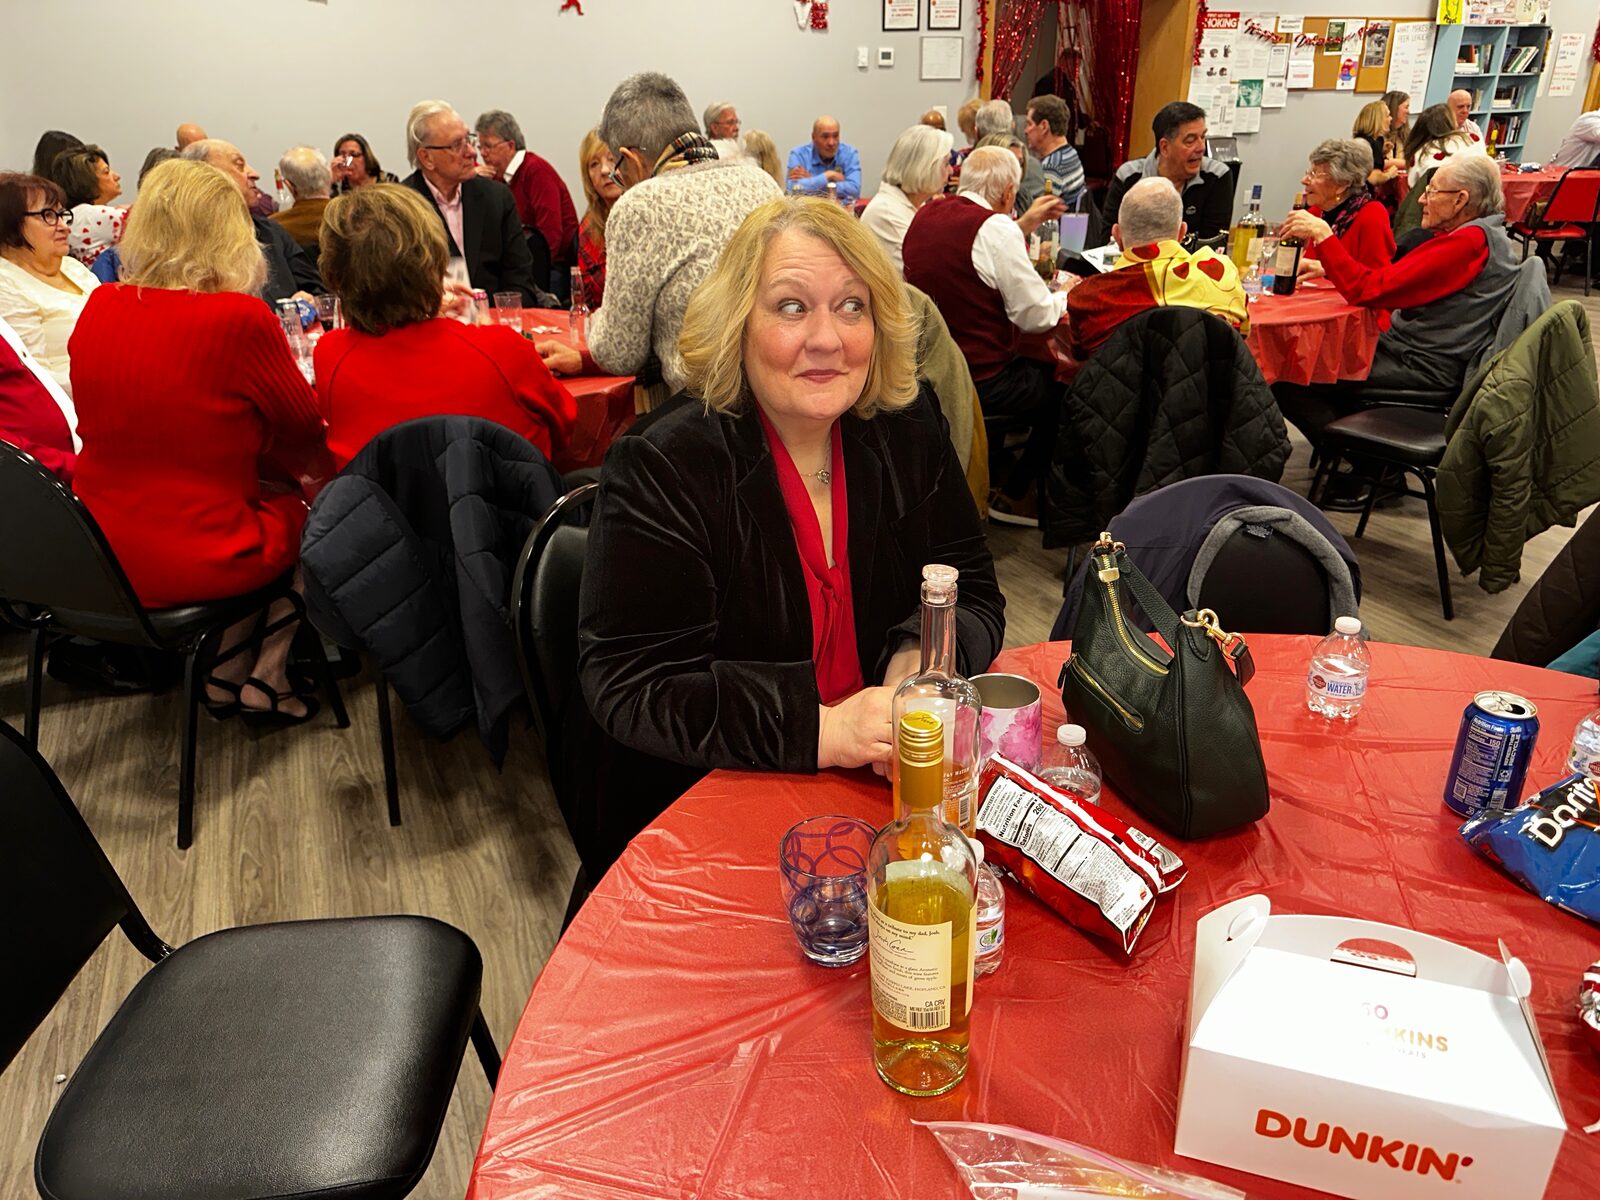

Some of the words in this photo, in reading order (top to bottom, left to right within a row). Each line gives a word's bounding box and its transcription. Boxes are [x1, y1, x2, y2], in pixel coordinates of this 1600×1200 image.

[1327, 682, 1352, 695] WATER
[999, 808, 1016, 838] Nutrition
[1020, 824, 1032, 846] Calories
[1033, 803, 1044, 815] 260
[1254, 1107, 1474, 1182] DUNKIN'
